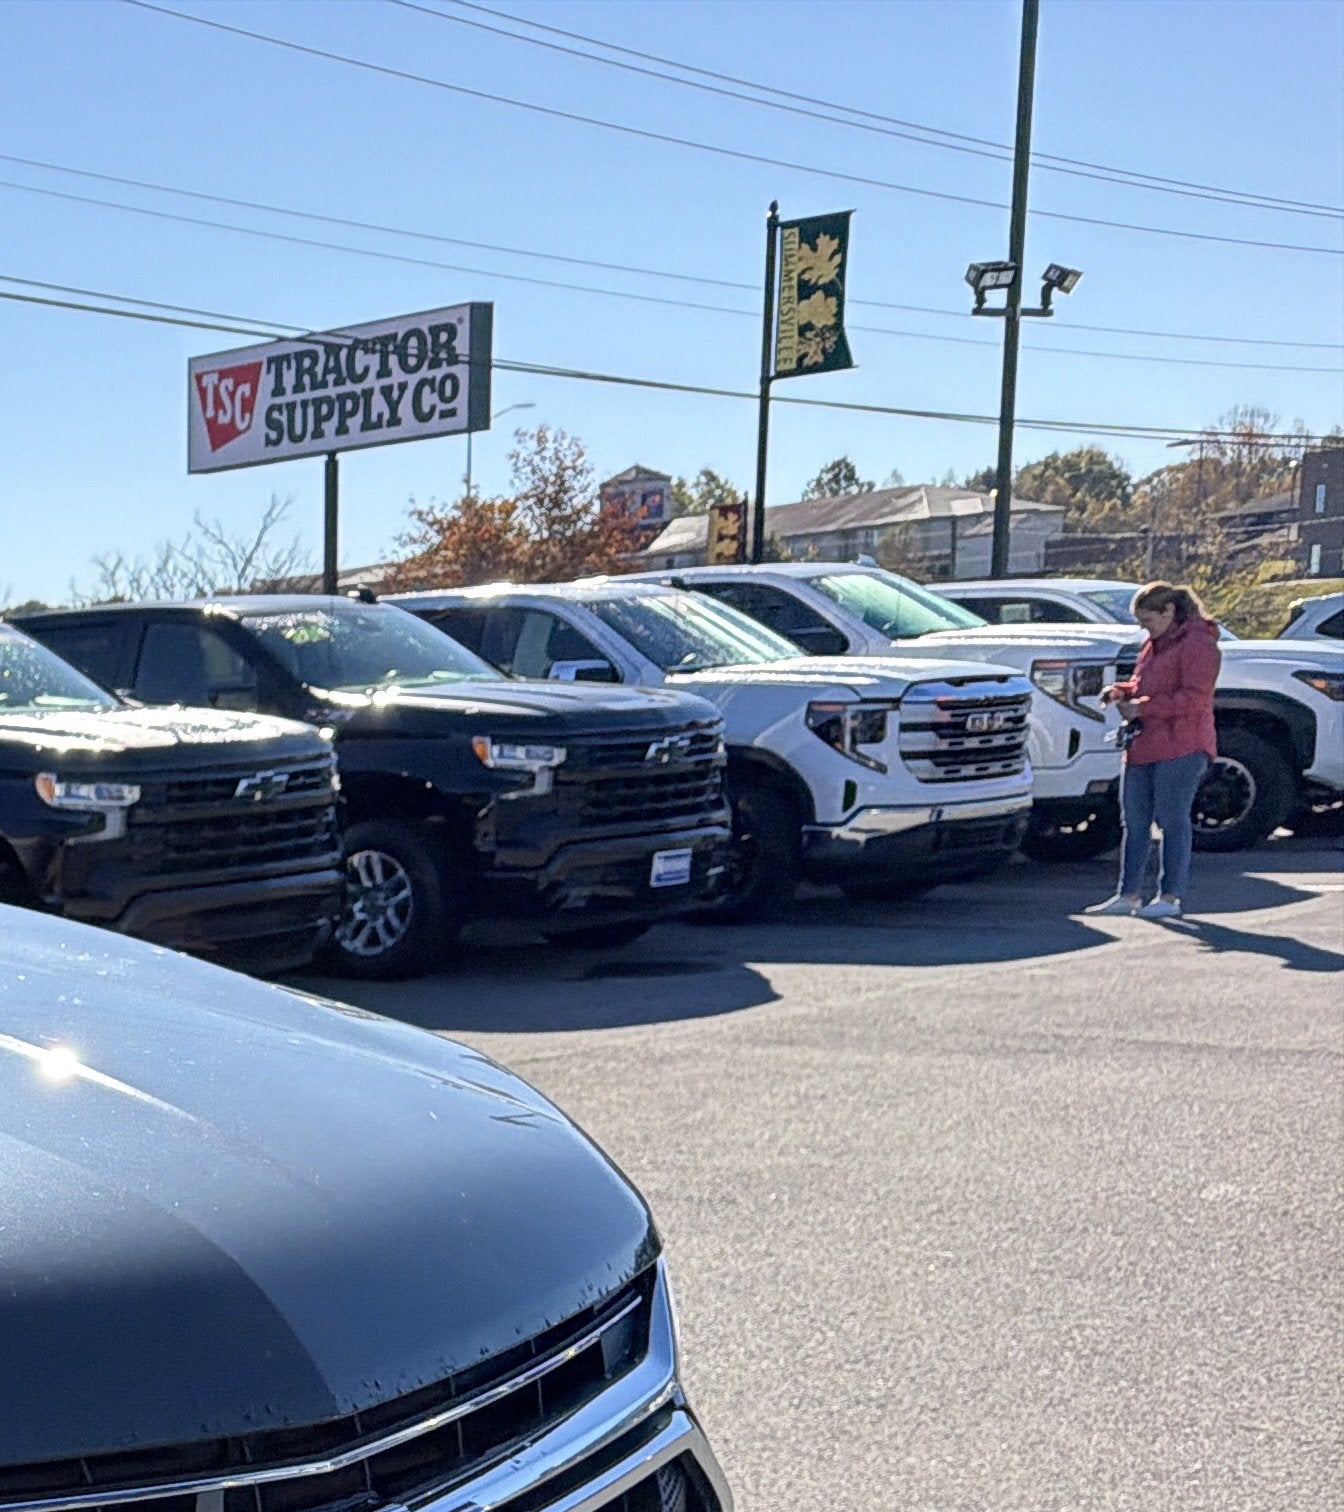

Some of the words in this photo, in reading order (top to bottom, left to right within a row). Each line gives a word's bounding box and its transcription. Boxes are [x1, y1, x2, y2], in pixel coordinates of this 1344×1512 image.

[266, 322, 459, 398] TRACTOR
[202, 373, 251, 431] TSC
[264, 382, 408, 448] SUPPLY
